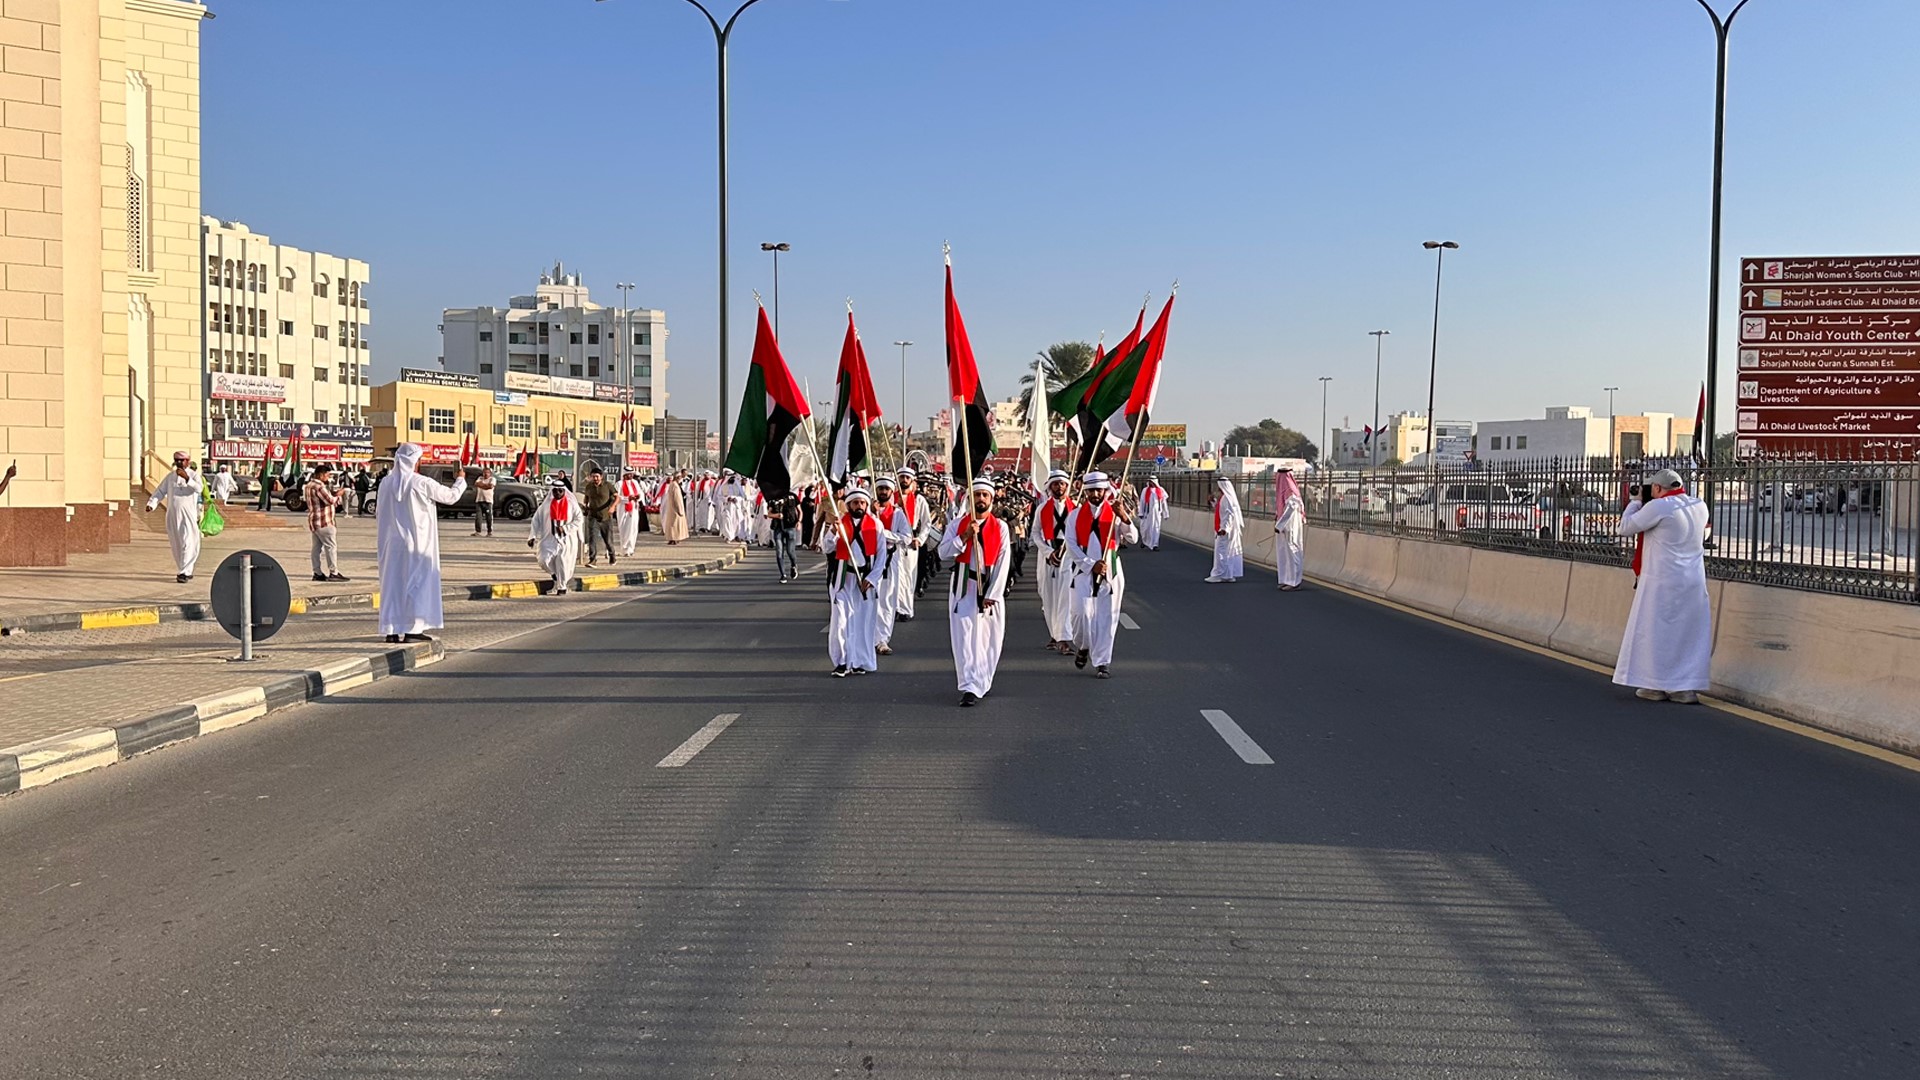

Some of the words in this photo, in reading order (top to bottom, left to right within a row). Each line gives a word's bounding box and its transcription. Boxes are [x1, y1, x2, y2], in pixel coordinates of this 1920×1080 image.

[1855, 271, 1881, 279] Sports
[1769, 316, 1813, 327] الذيد
[1818, 316, 1862, 325] ناشئة
[1867, 315, 1911, 327] مركز
[1769, 331, 1782, 340] Al
[1786, 331, 1822, 340] Dhaid
[1826, 330, 1863, 340] Youth
[1867, 330, 1910, 340] Center
[1761, 360, 1790, 368] Sharjah
[1833, 376, 1859, 384] والثروة
[1862, 376, 1892, 384] الزراعة
[1760, 387, 1810, 395] Department
[1824, 387, 1872, 395] Agriculture
[1833, 412, 1867, 422] للمواشي
[234, 421, 260, 429] ROYAL
[262, 422, 297, 431] MEDICAL
[246, 429, 282, 437] CENTER
[312, 426, 332, 438] الطبي
[333, 427, 352, 437] رويال
[353, 428, 370, 438] مركز
[215, 442, 238, 456] KHALID
[240, 443, 268, 457] PHARMAC
[1473, 511, 1527, 520] NSSAN
